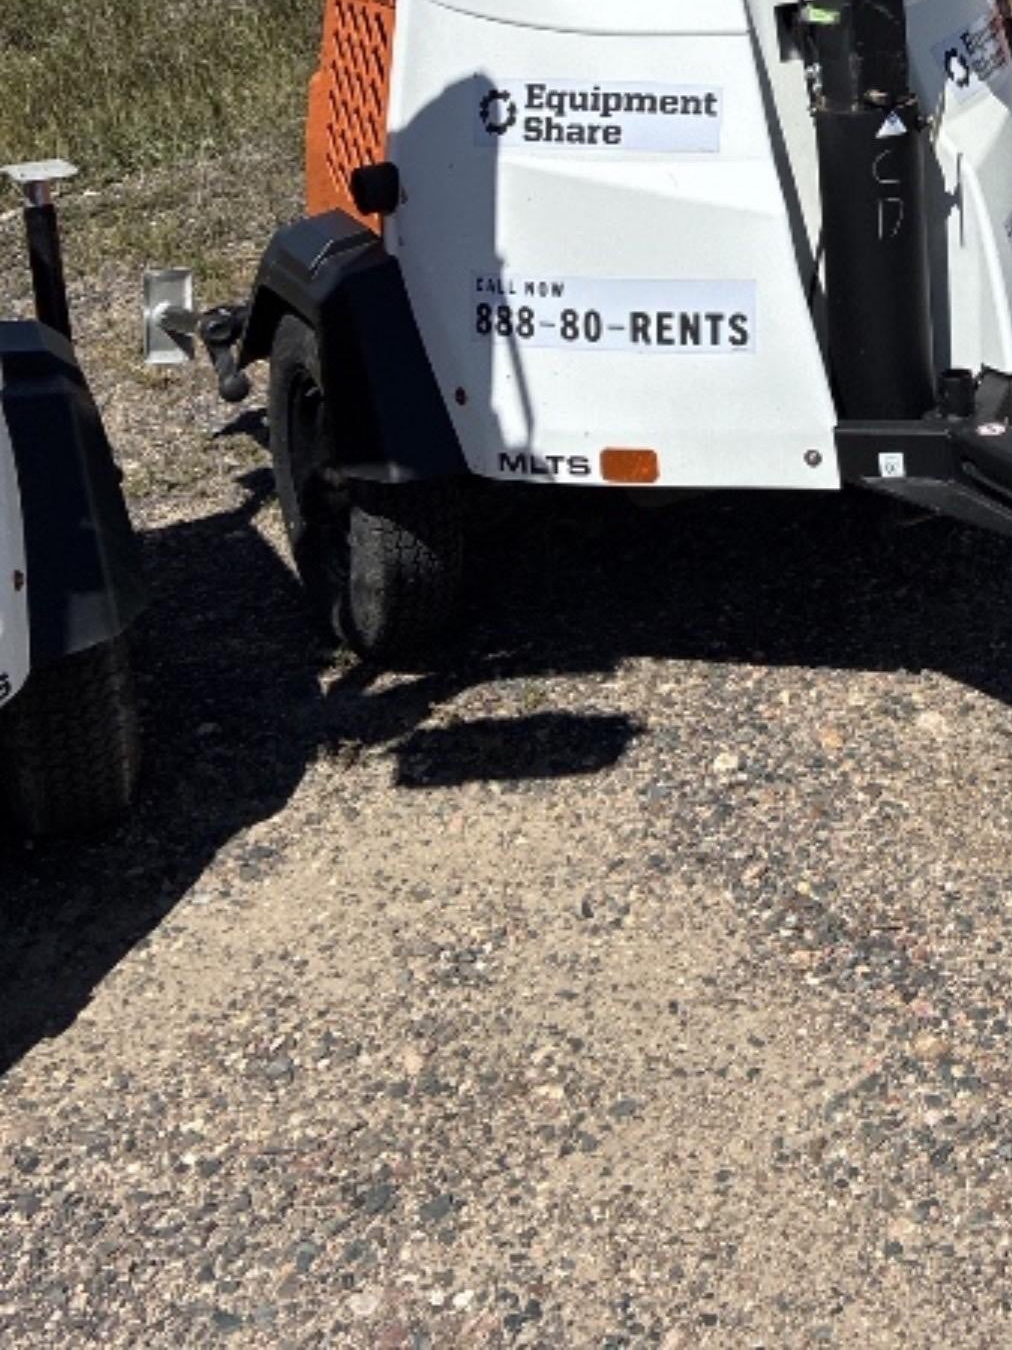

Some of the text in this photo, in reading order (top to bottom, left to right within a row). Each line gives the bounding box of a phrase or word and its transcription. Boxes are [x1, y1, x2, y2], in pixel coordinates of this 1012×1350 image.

[524, 83, 718, 117] Equipment
[523, 116, 622, 145] Share
[475, 278, 564, 297] CALL NOW
[475, 302, 749, 347] 888-80-RENTS
[497, 452, 591, 476] MLTS
